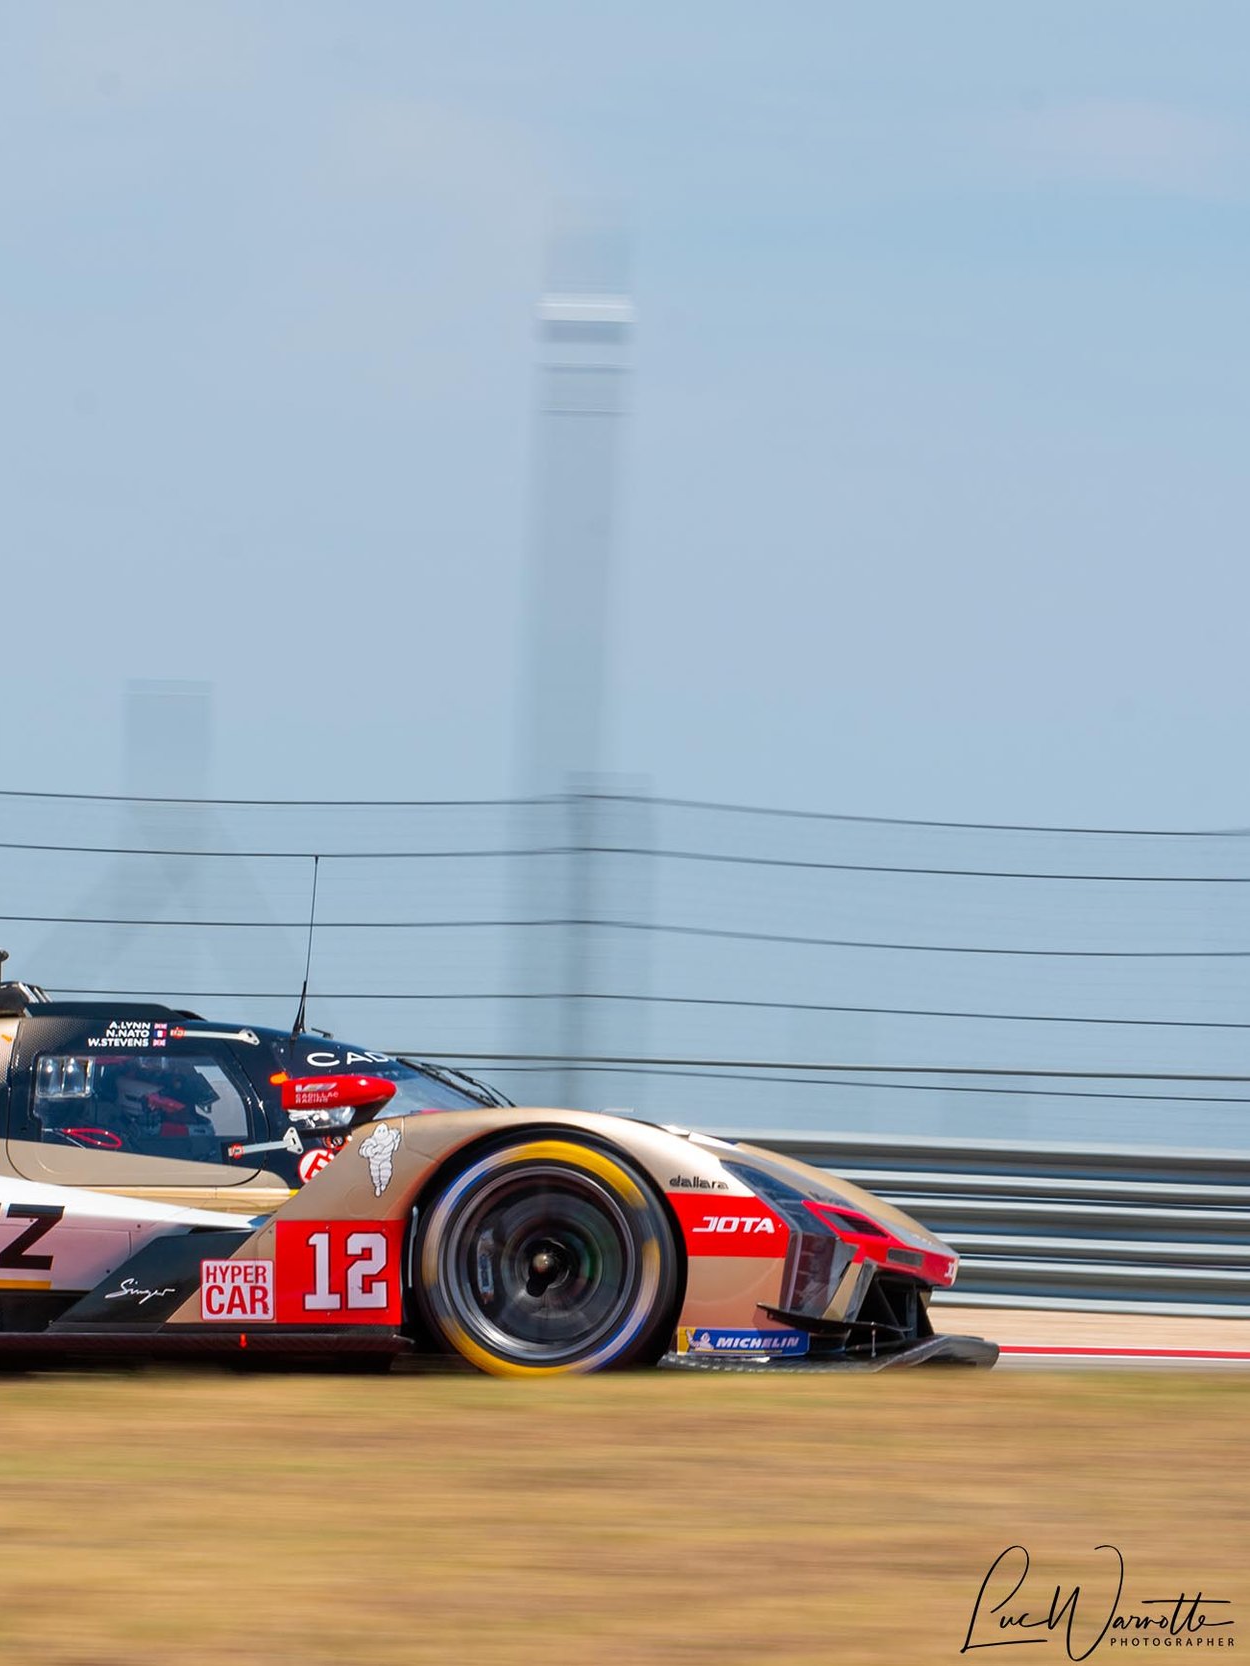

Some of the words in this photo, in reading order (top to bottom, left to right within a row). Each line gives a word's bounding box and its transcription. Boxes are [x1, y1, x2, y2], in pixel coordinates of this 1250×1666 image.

[106, 1029, 150, 1038] N.NATO
[109, 1021, 151, 1030] A.LYNN
[88, 1038, 149, 1047] W.STEVENS
[306, 1051, 396, 1067] CAD
[669, 1175, 729, 1190] dallara
[692, 1216, 775, 1234] JOTA
[205, 1265, 267, 1284] HYPER
[303, 1232, 388, 1311] 12
[104, 1278, 176, 1305] Singer
[205, 1285, 270, 1316] CAR
[716, 1337, 800, 1349] MICHELIN
